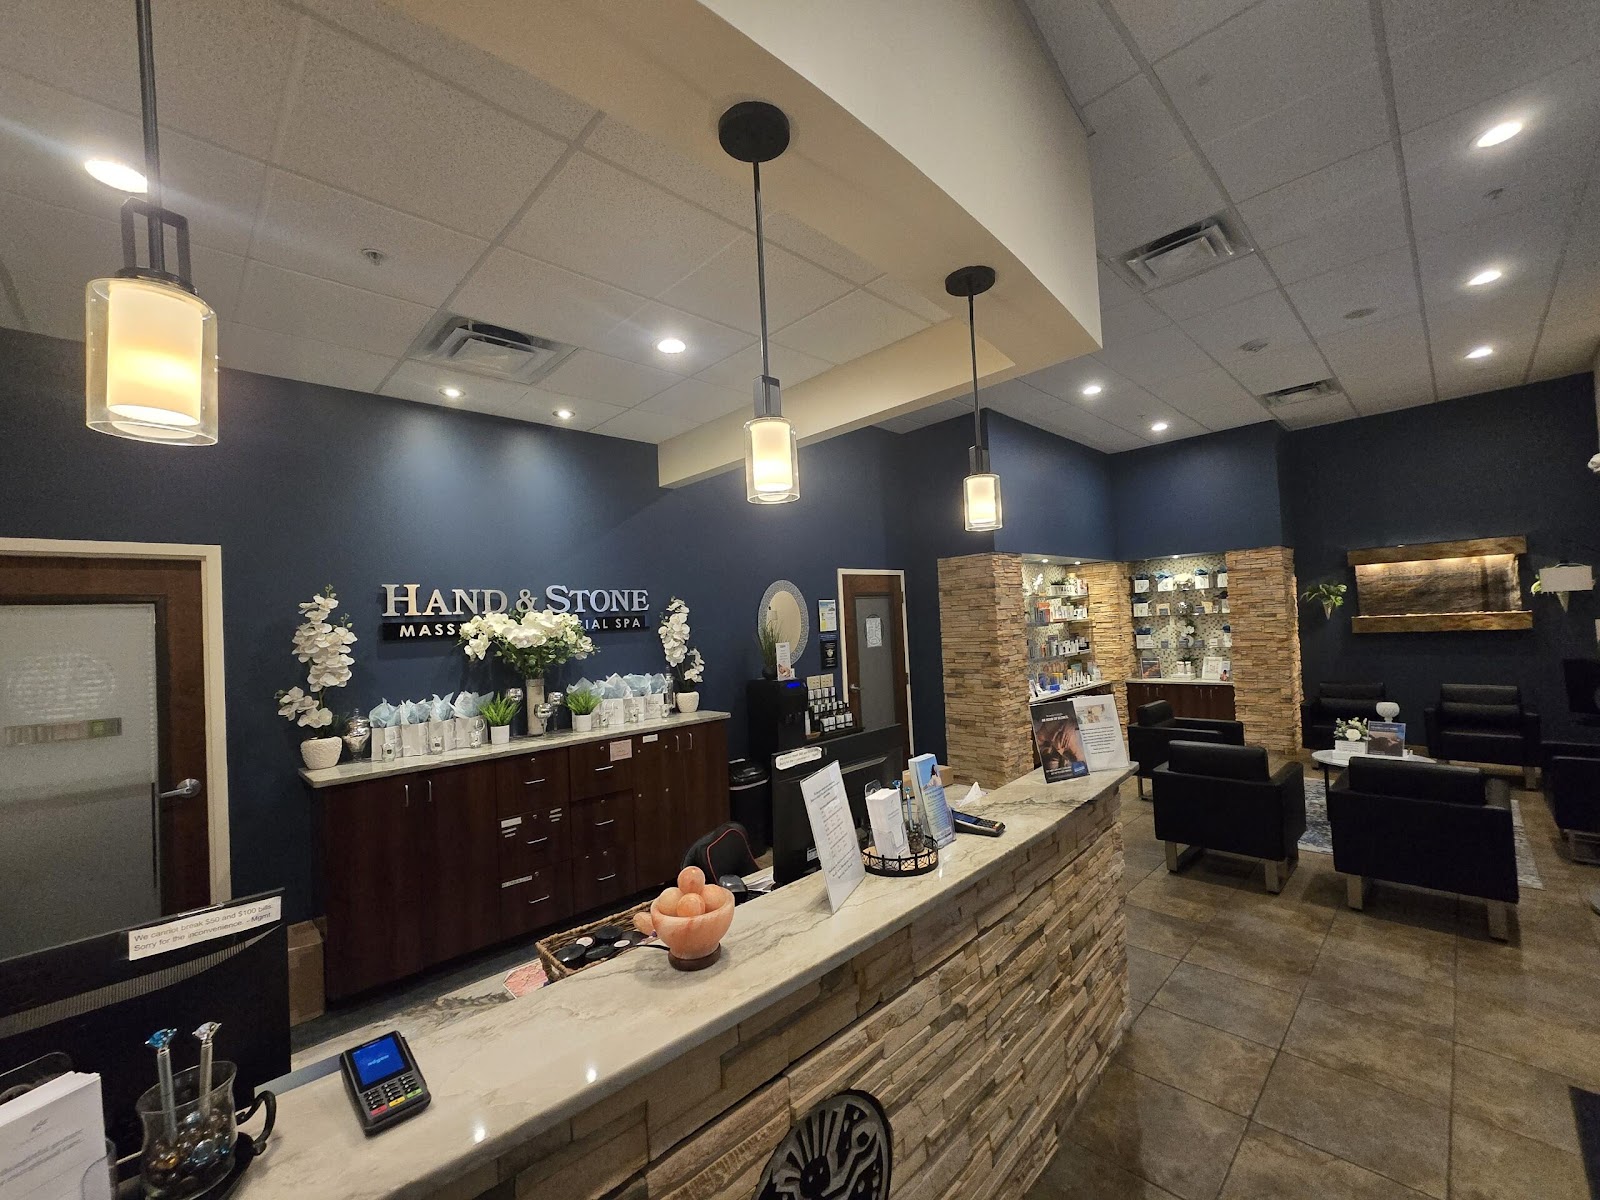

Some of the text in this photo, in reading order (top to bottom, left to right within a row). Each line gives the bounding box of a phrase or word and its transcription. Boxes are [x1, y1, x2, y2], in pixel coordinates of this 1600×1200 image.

[381, 583, 650, 617] HAND & STONE
[615, 617, 641, 629] SPA
[134, 934, 149, 943] We
[150, 926, 179, 939] cannot
[180, 920, 204, 931] break
[205, 916, 220, 926] $50
[221, 912, 236, 921] and
[237, 907, 257, 917] $100
[133, 942, 157, 952] Sorry
[159, 937, 171, 946] for
[172, 934, 186, 943] the
